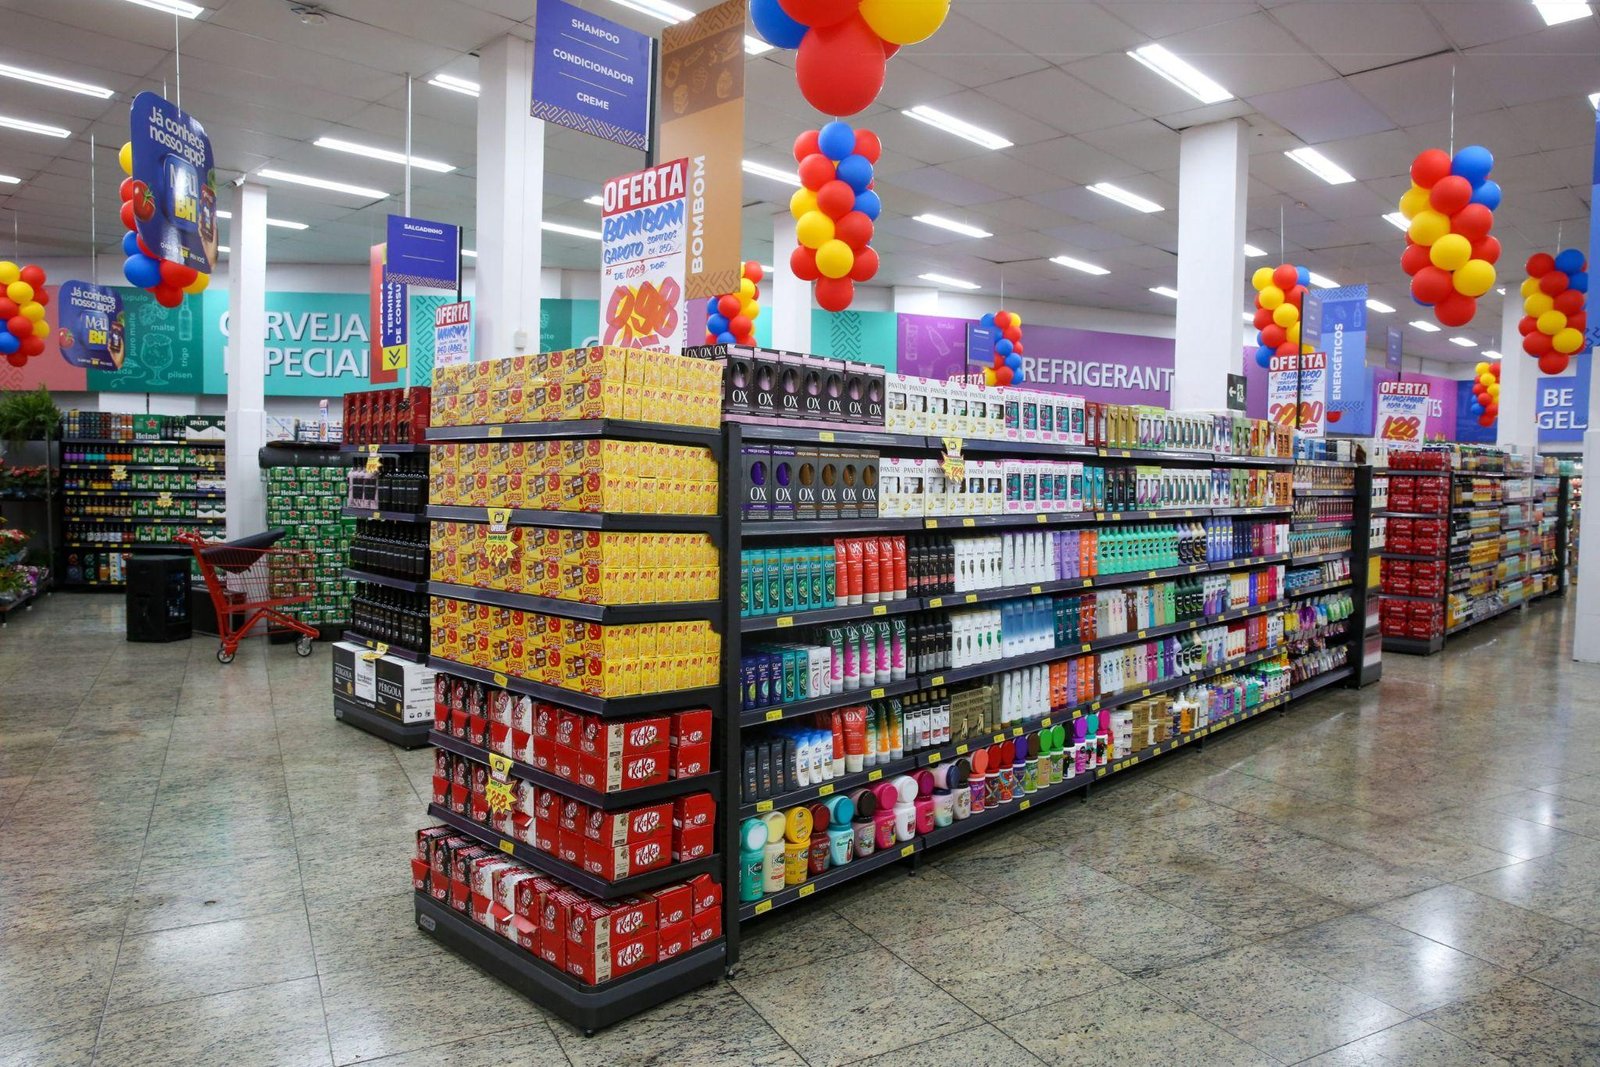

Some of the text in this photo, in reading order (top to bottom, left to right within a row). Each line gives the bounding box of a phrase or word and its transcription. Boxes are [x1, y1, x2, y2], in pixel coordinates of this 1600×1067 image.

[571, 18, 620, 45] SHAMPOO
[552, 48, 634, 85] CONDICIONADOR
[576, 91, 610, 110] CREME
[149, 106, 205, 151] Já conhece
[150, 125, 206, 168] nosso app?
[603, 162, 685, 213] OFERTA
[175, 196, 197, 223] BH
[691, 155, 706, 274] BOMBOM
[404, 223, 443, 235] SALGADINHO
[604, 241, 644, 265] GAROTO
[71, 287, 116, 304] Já conhece
[71, 298, 116, 313] nosso app?
[436, 303, 469, 326] OFERTA
[151, 323, 176, 331] malte
[218, 311, 369, 343] CRVEJA
[395, 327, 402, 344] DE
[89, 330, 107, 345] BH
[182, 347, 190, 367] trigo
[700, 347, 712, 358] OX
[714, 345, 727, 356] OX
[223, 347, 370, 378] PECIA
[1269, 354, 1325, 371] OFERTA
[1333, 323, 1344, 400] ENERGÉTICOS
[168, 371, 193, 379] pilsen
[949, 373, 984, 386] OFERTA
[732, 389, 749, 403] OX
[1381, 382, 1429, 396] OFERTA
[1543, 388, 1574, 407] BE
[758, 392, 774, 406] OX
[783, 394, 799, 408] OX
[806, 397, 821, 410] OX
[828, 399, 842, 412] OX
[849, 401, 863, 414] OX
[869, 403, 882, 416] OX
[750, 487, 767, 501] OX
[775, 488, 792, 501] OX
[799, 488, 815, 501] OX
[821, 488, 837, 501] OX
[842, 488, 857, 501] OX
[862, 487, 877, 501] OX
[335, 665, 352, 678] PÉRGOLA
[378, 681, 402, 698] PÉRGOLA
[631, 725, 657, 746] KitKat
[629, 758, 656, 779] KitKat
[635, 812, 660, 832] KitKat
[637, 843, 661, 865] KitKat
[616, 911, 644, 934] KitKat
[618, 943, 644, 966] KitKat
